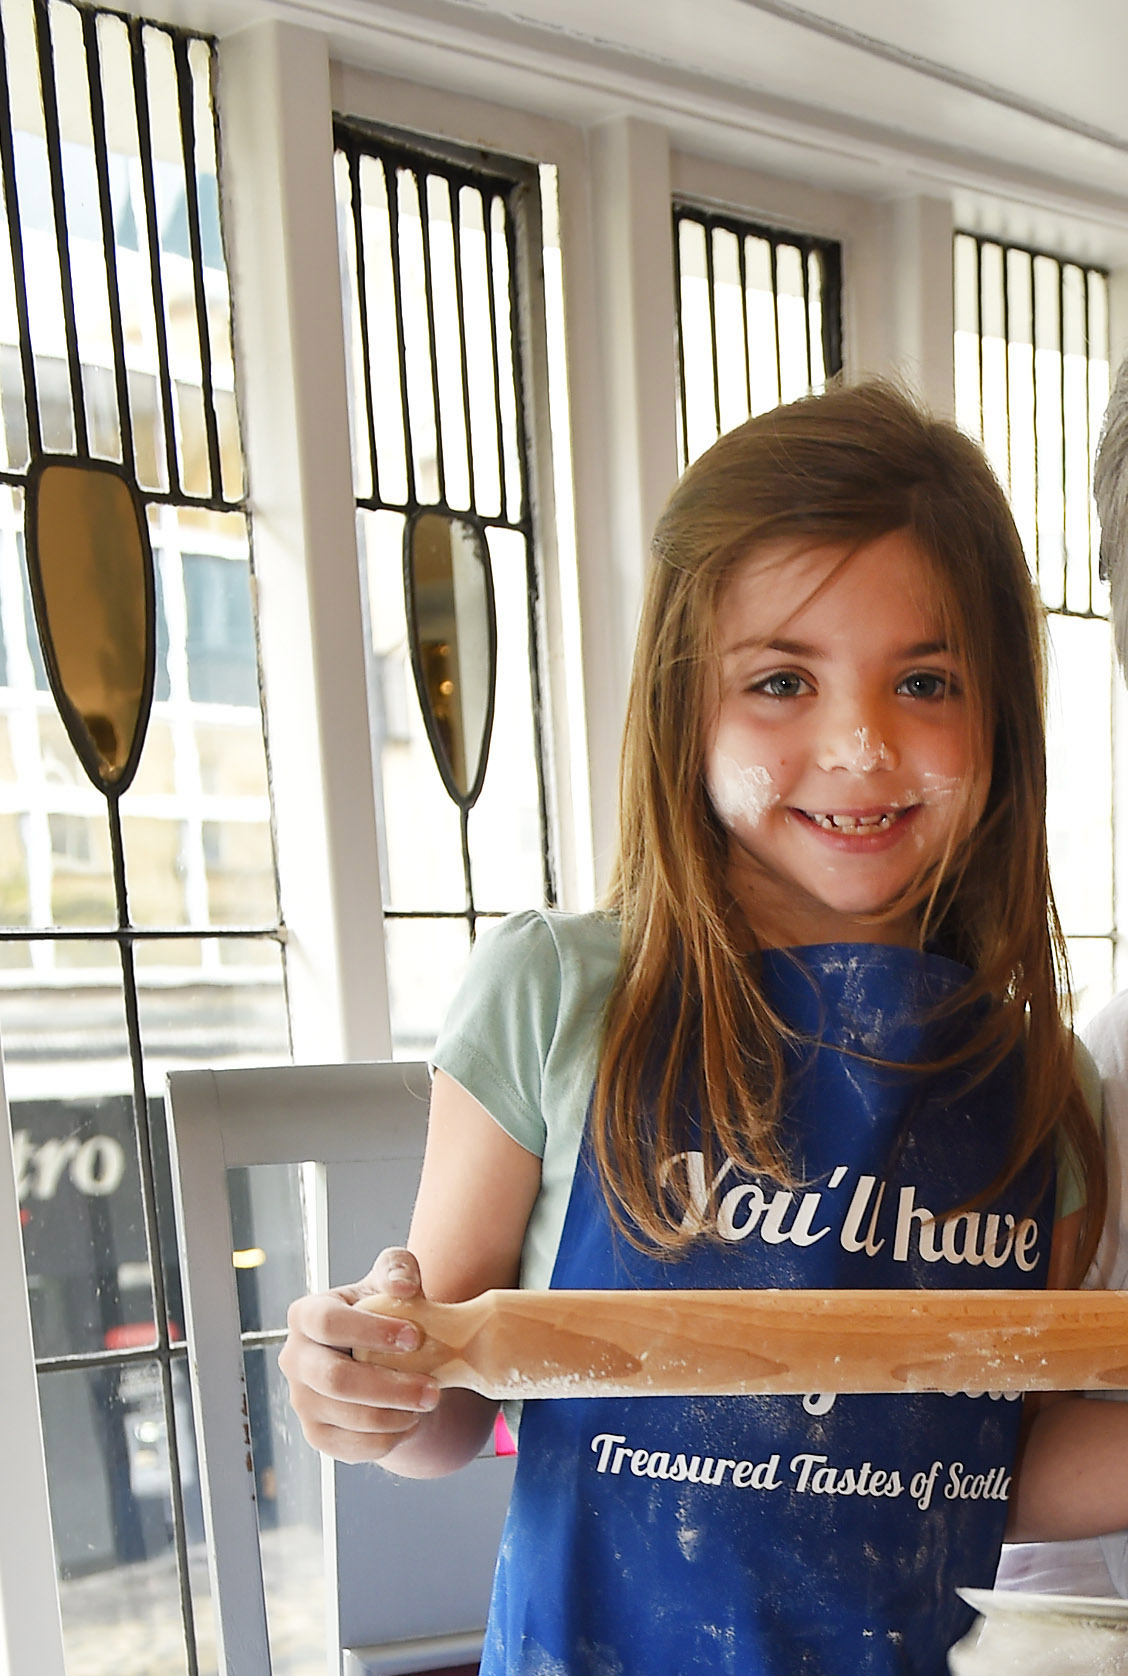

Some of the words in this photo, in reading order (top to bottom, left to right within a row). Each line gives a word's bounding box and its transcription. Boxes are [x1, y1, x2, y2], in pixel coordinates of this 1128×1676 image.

[13, 1129, 126, 1201] tro
[893, 1186, 1041, 1273] have
[590, 1433, 783, 1492] Treasured
[789, 1453, 905, 1501] Tastes
[909, 1460, 943, 1511] of
[943, 1462, 1011, 1502] Scotl
